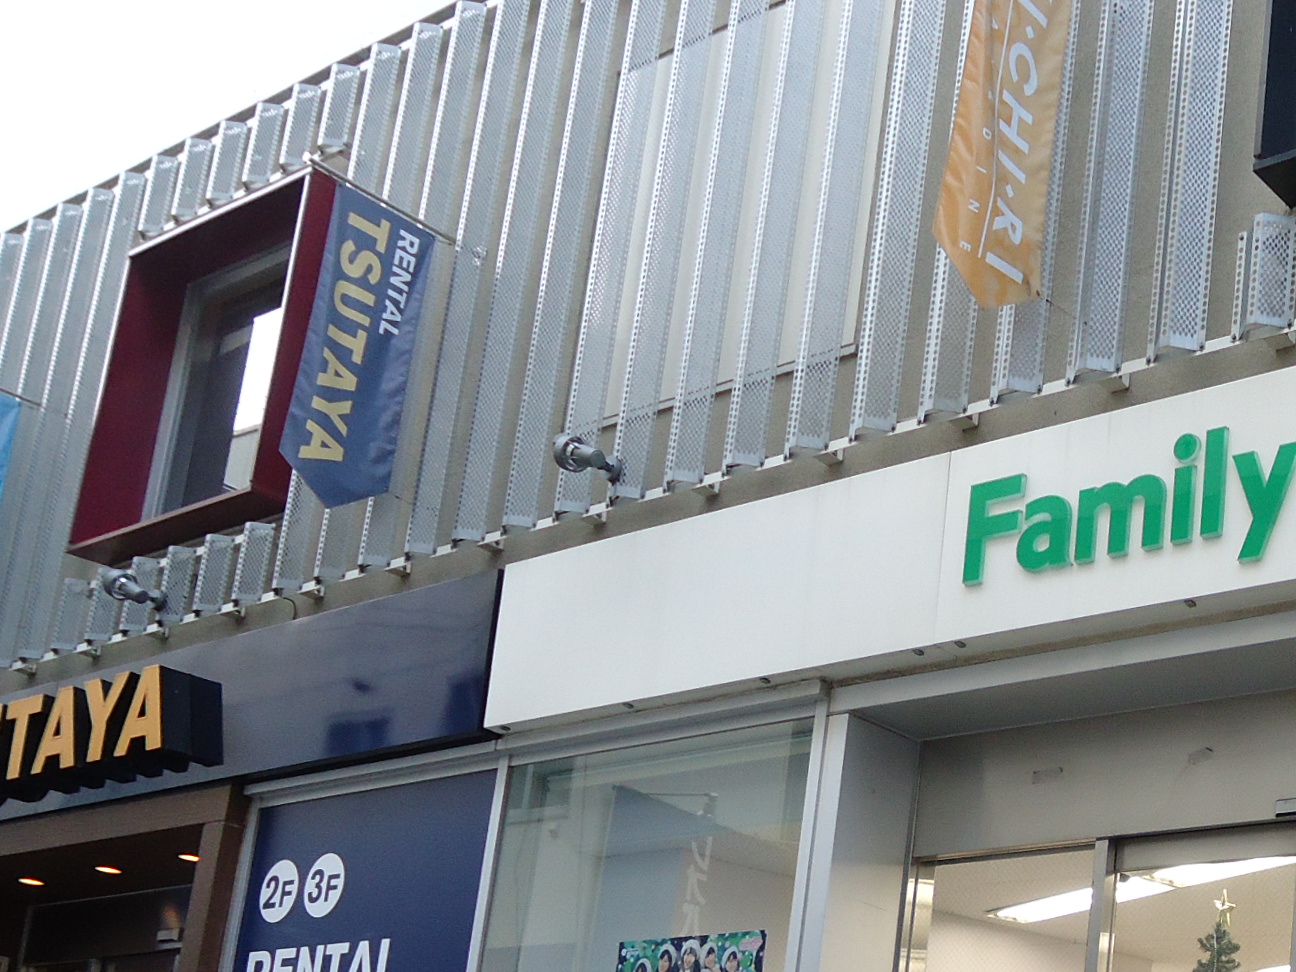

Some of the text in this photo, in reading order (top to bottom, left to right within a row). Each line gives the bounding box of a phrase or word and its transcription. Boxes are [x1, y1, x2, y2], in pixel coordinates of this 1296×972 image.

[298, 211, 391, 462] TSUTAYA
[379, 229, 420, 336] RENTAL
[0, 664, 162, 781] TAYA
[262, 869, 341, 909] 2F 3F
